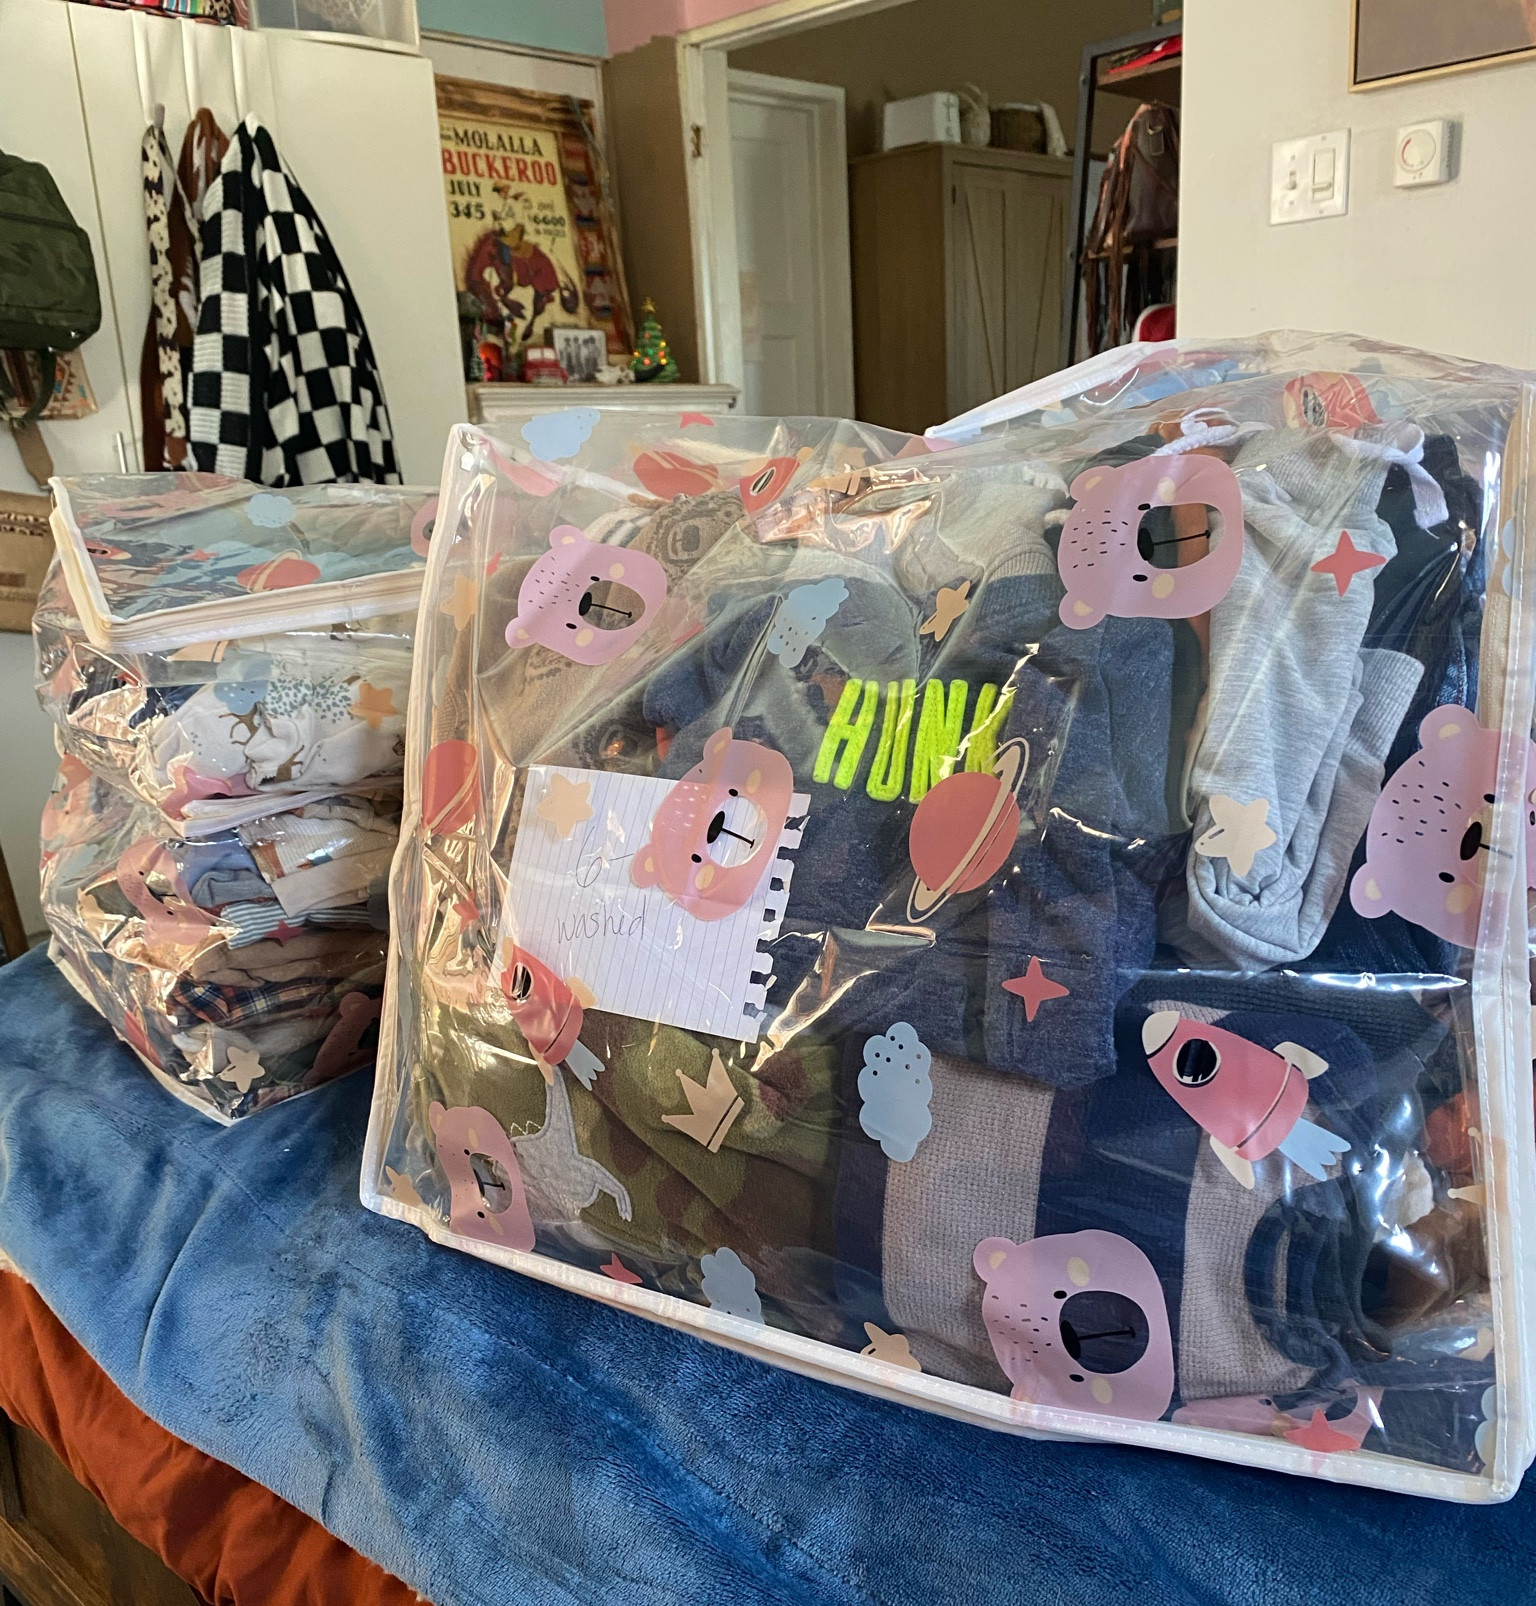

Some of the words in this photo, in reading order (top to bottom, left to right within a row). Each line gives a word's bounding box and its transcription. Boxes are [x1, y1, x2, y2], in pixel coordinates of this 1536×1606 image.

[452, 127, 544, 157] MOLALLA
[441, 148, 558, 186] BUCKEROO
[449, 179, 482, 197] JULY
[813, 678, 1015, 805] HUNK
[557, 894, 646, 944] washed
